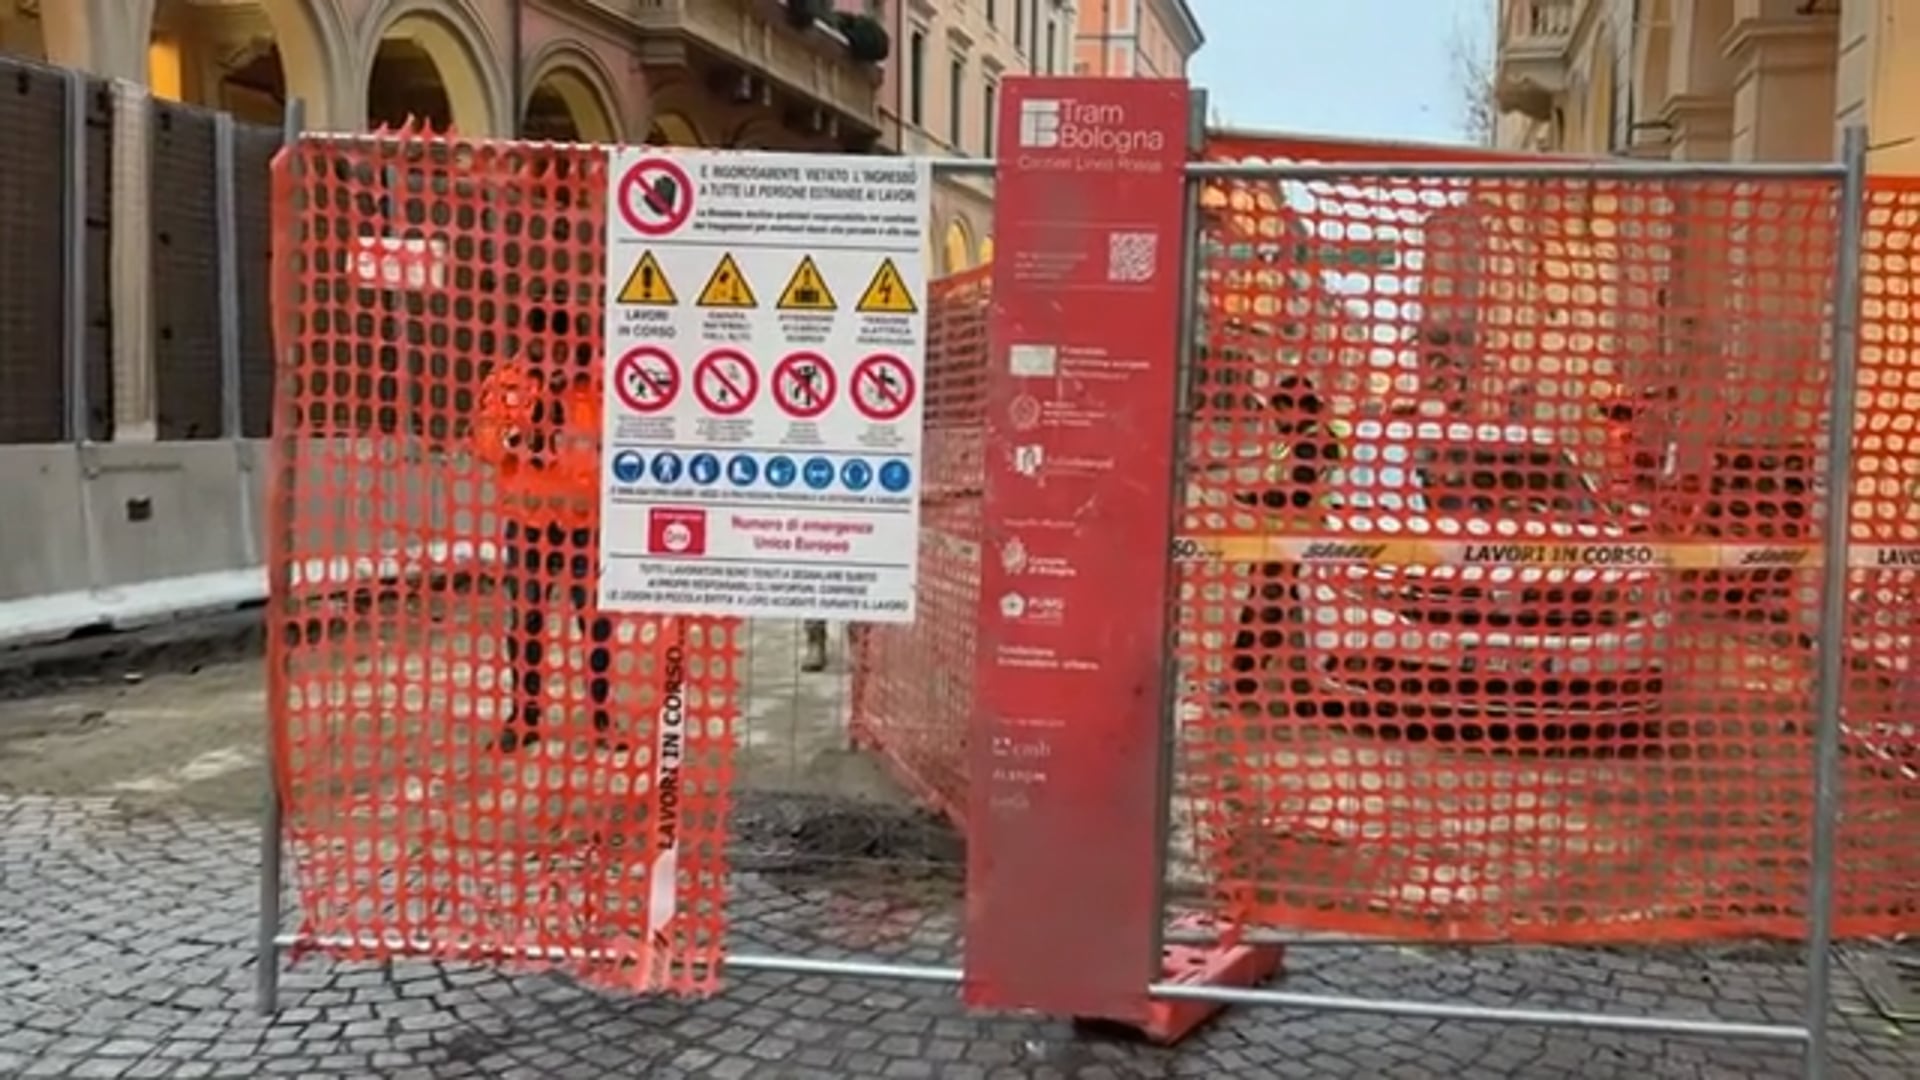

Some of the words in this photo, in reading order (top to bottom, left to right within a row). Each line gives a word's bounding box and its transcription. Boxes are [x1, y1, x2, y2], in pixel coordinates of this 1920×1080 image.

[1061, 98, 1124, 124] Tram
[1061, 122, 1164, 154] Bologna
[713, 164, 799, 183] RIGOROSAMENTE
[803, 168, 848, 183] VIETATO
[759, 185, 805, 200] PERSONE
[625, 309, 669, 322] LAVORI
[617, 325, 631, 337] IN
[633, 325, 677, 340] CORSO
[731, 515, 783, 531] Numero
[753, 535, 791, 550] Unico
[794, 537, 850, 553] Europeo
[1463, 545, 1544, 563] LAVORI
[1548, 546, 1577, 563] IN
[661, 733, 680, 760] IN
[657, 763, 678, 850] LAVORI
